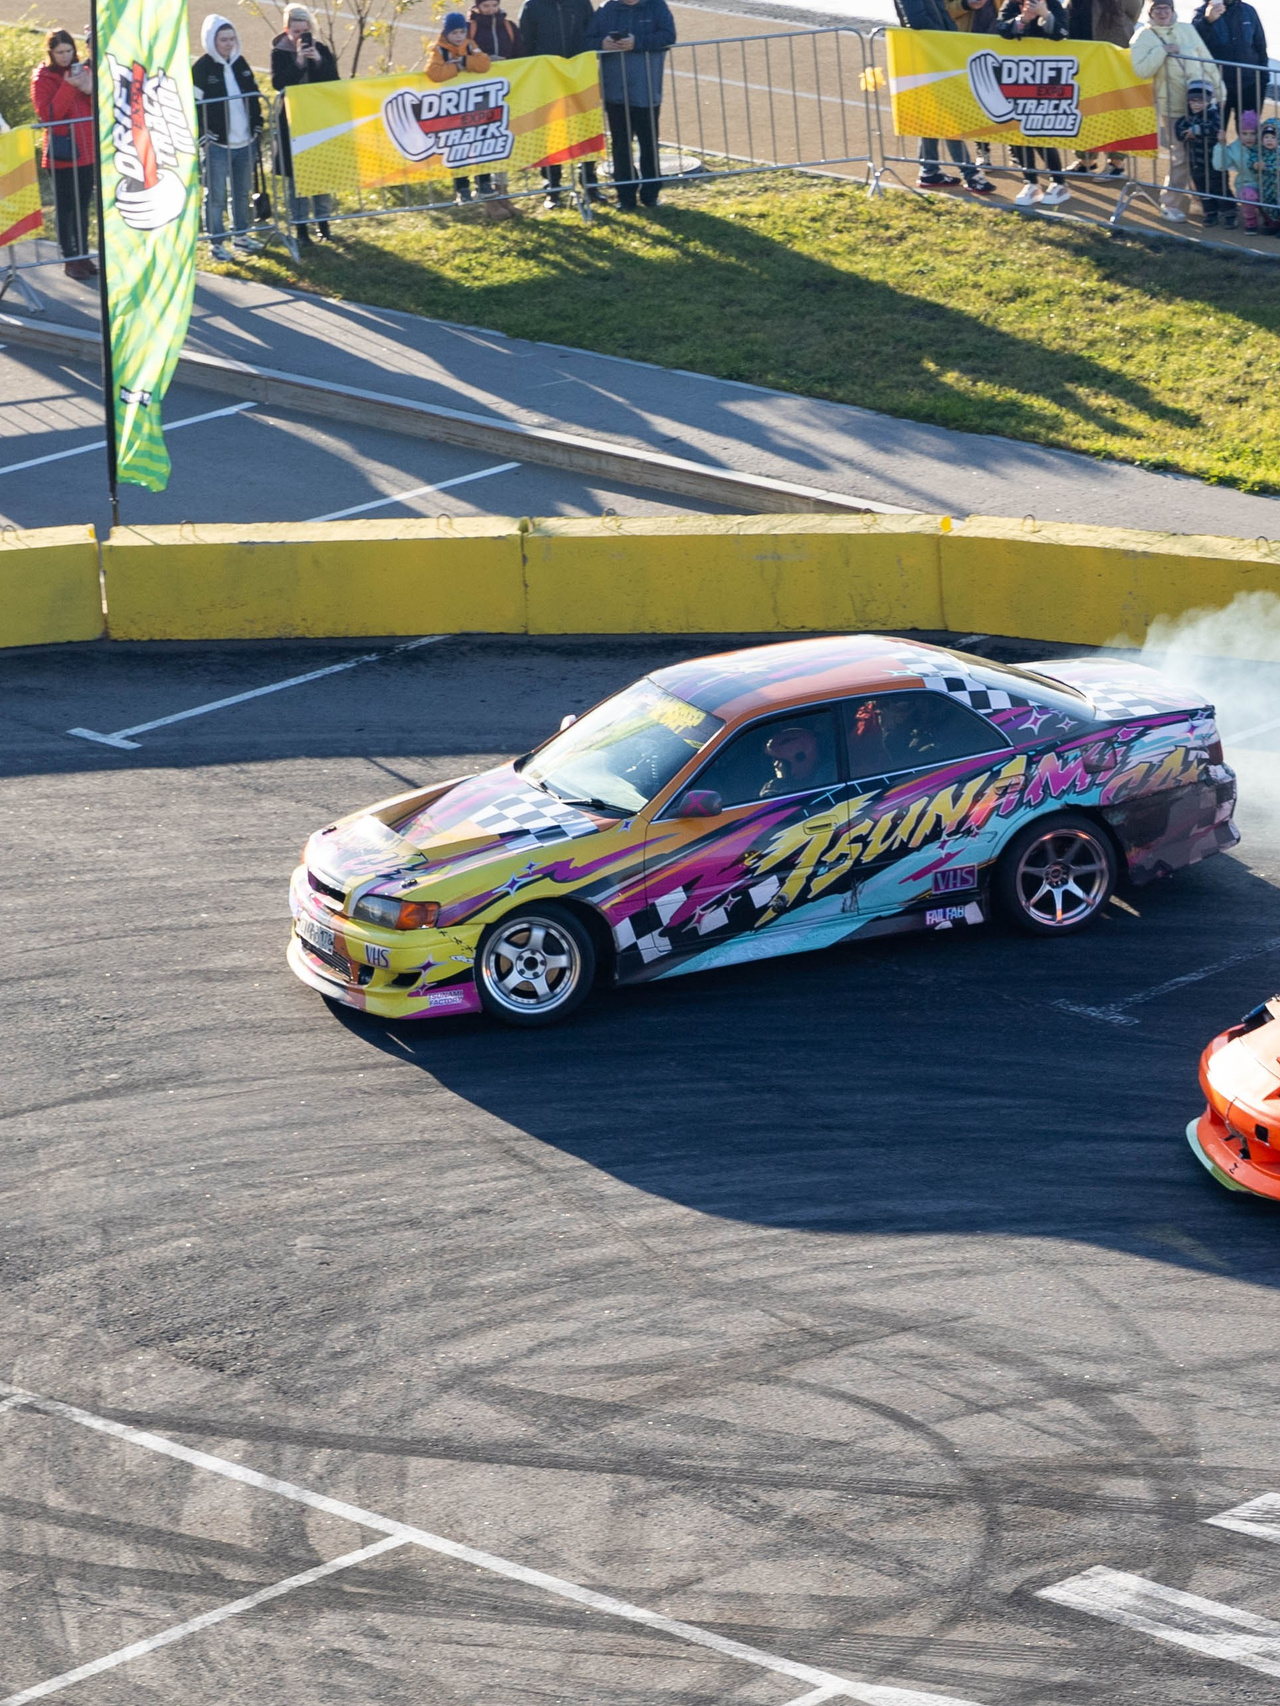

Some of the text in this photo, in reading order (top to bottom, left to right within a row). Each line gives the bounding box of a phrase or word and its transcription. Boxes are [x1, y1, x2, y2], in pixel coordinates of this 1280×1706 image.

[1001, 60, 1074, 84] DRIFT
[420, 81, 503, 120] DRIFT
[1016, 99, 1073, 114] TRACK
[106, 53, 145, 181] DRIFT
[1025, 115, 1076, 130] MODE
[437, 122, 502, 147] TRACK
[448, 136, 507, 161] MODE
[937, 867, 974, 889] VHS
[365, 944, 390, 968] VHS
[429, 997, 463, 1006] FACTORY
